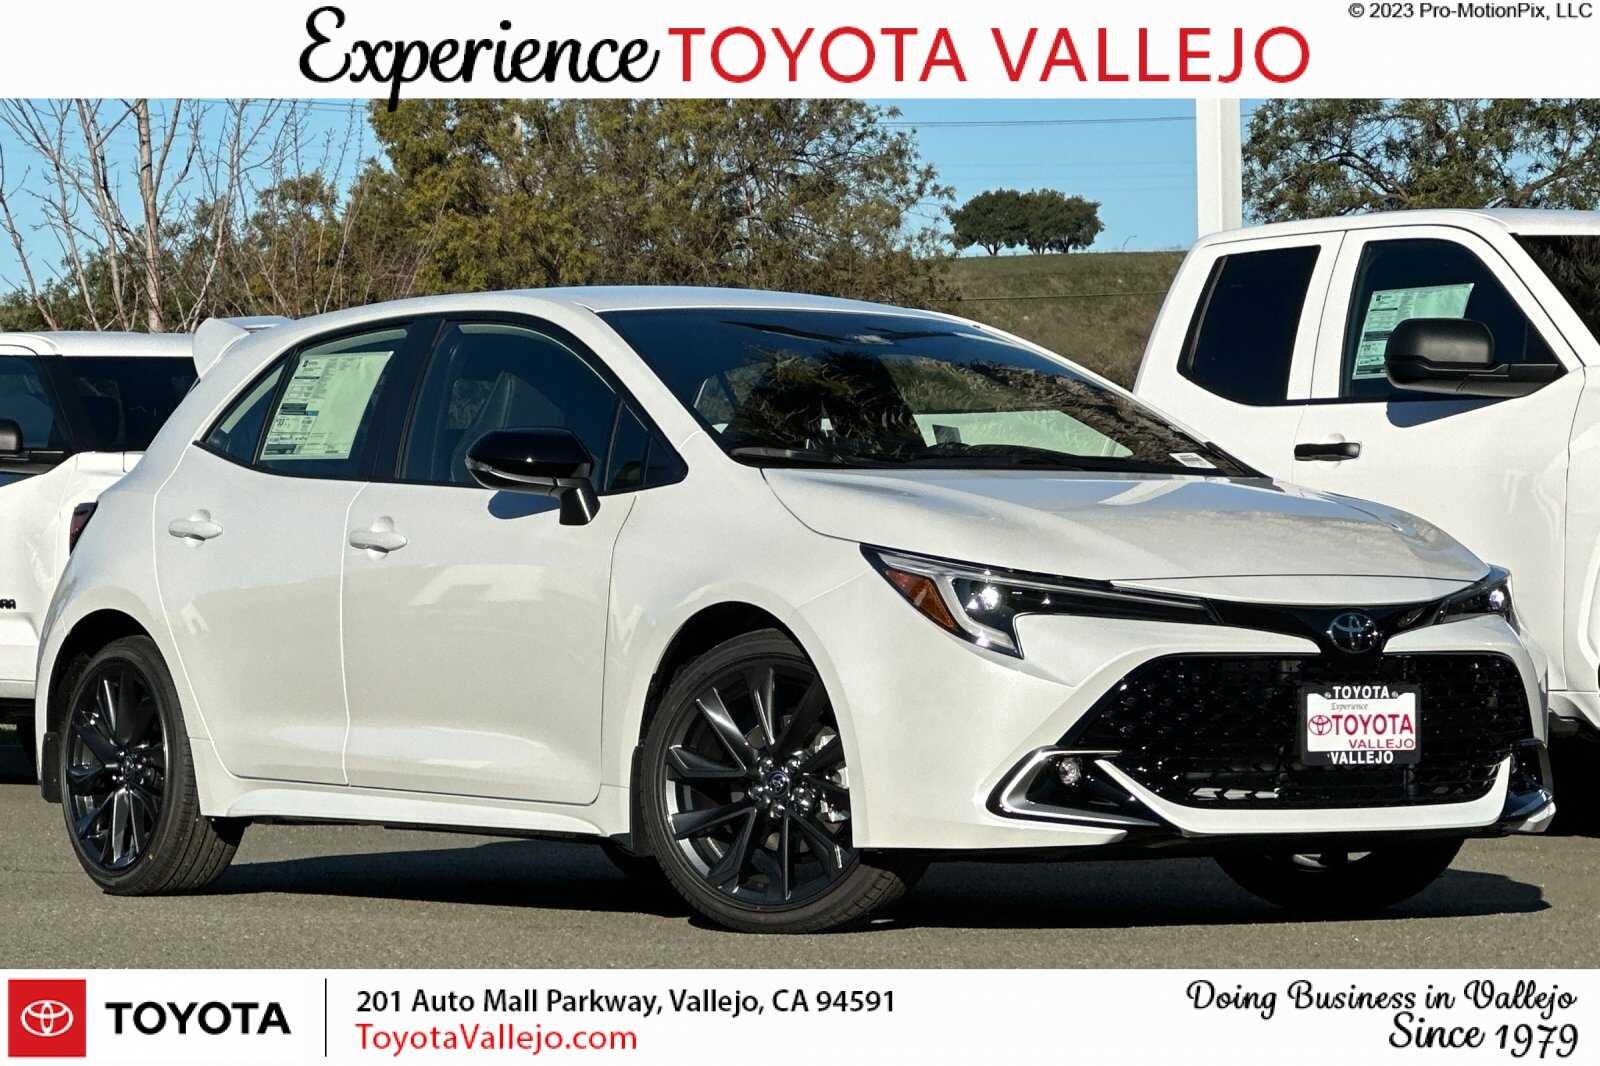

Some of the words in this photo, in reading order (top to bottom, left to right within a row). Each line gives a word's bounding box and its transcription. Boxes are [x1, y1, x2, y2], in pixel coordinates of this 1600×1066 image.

[1333, 686, 1390, 699] TOYOTA
[1331, 702, 1369, 712] Experience
[1331, 714, 1414, 736] TOYOTA
[1349, 738, 1415, 749] VALLEJO
[1330, 751, 1393, 764] VALLEJO
